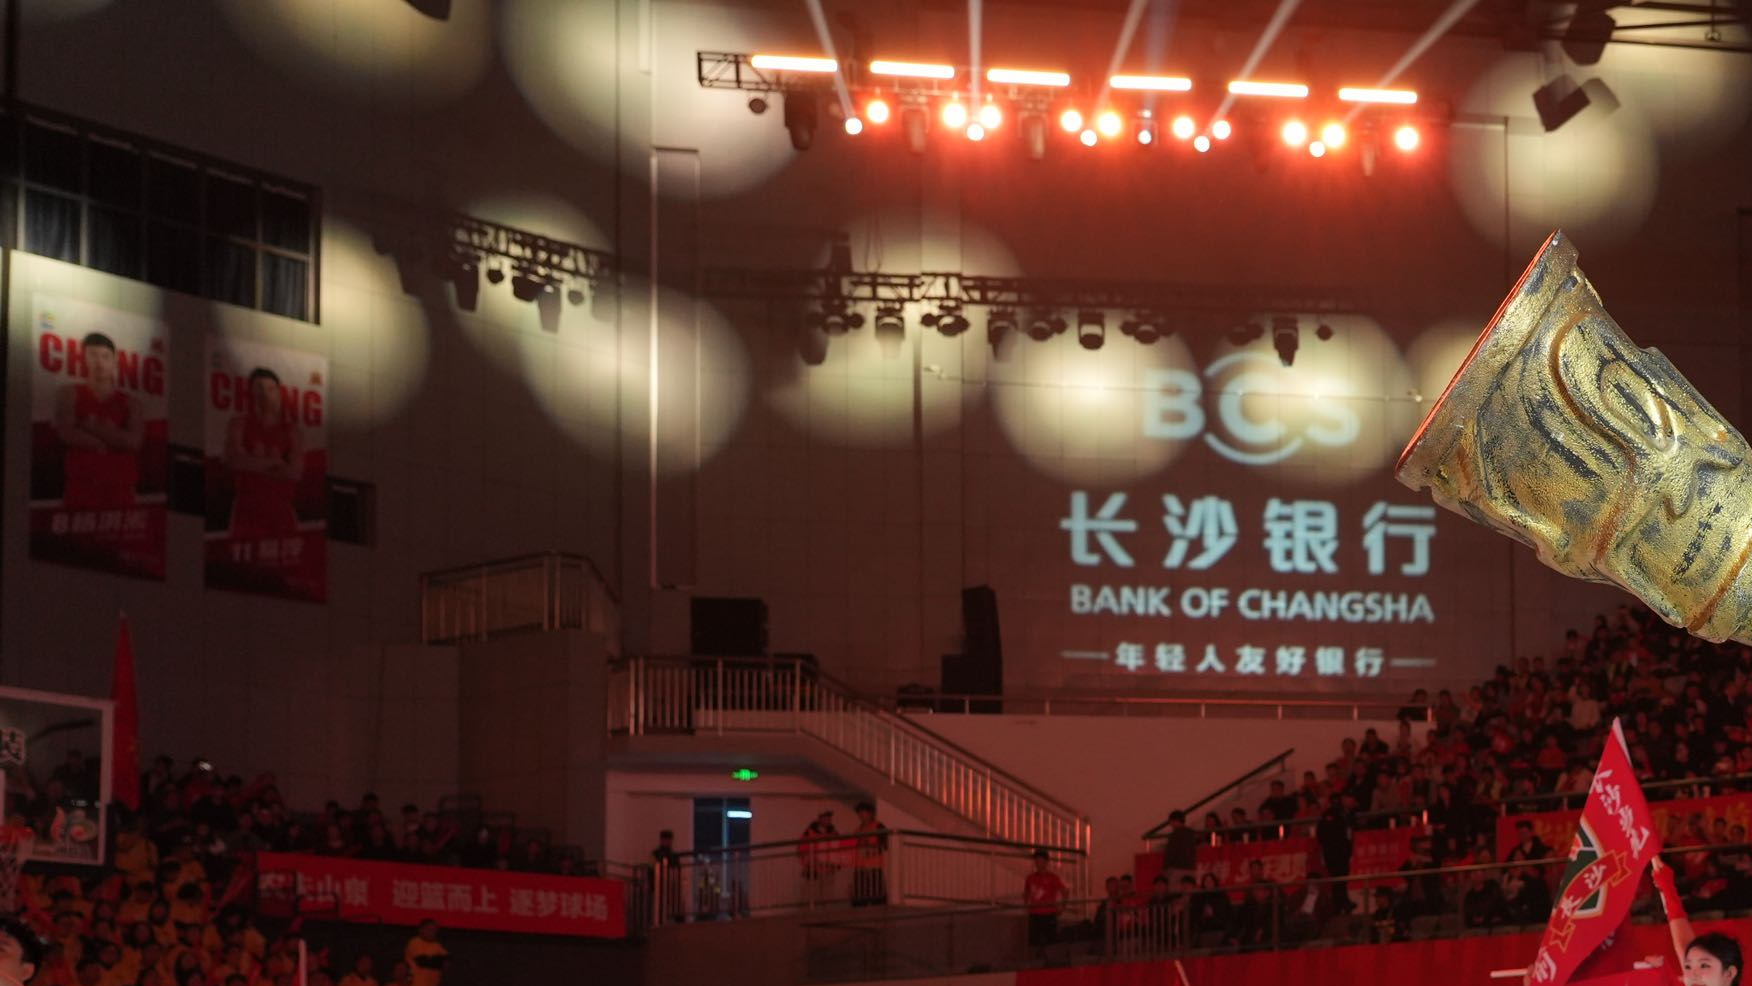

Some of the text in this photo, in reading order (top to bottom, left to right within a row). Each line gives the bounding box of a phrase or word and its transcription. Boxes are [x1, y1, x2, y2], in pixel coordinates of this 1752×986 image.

[40, 332, 164, 397] CHNG
[210, 370, 323, 427] CHNG
[1142, 366, 1360, 447] BCS
[1060, 490, 1436, 576] 长沙银行
[1070, 585, 1435, 623] BANK OF CHANGSHA
[1116, 642, 1385, 677] 年轻人友好银行
